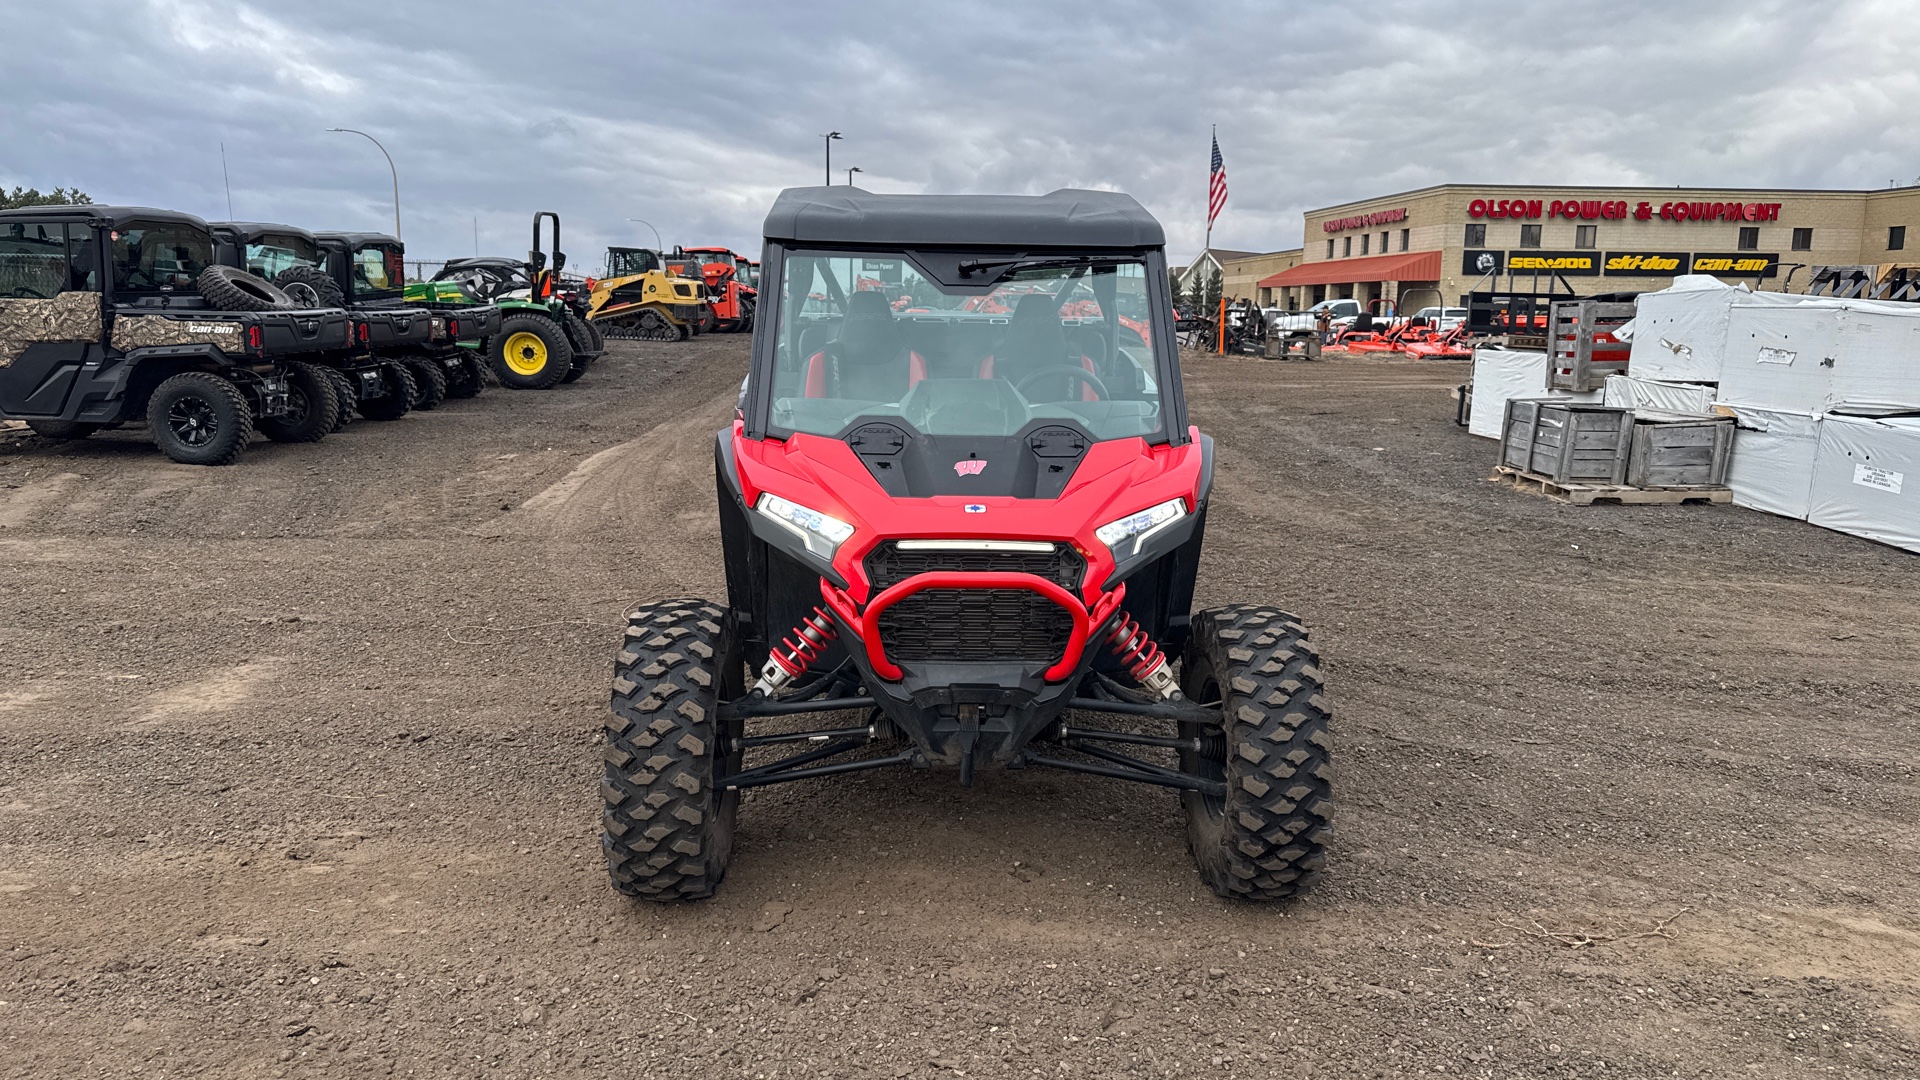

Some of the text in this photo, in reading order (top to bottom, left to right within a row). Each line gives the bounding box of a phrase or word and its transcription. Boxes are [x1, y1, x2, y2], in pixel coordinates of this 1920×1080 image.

[1469, 199, 1782, 222] OLSON POWER & EQUIPMENT
[1323, 219, 1342, 232] OLSON
[1342, 215, 1362, 229] POWER
[1369, 208, 1407, 225] EQUIPMENT
[880, 262, 894, 270] Power
[1605, 255, 1680, 270] ski-doo
[1693, 258, 1769, 271] can-am
[189, 325, 234, 334] can-am
